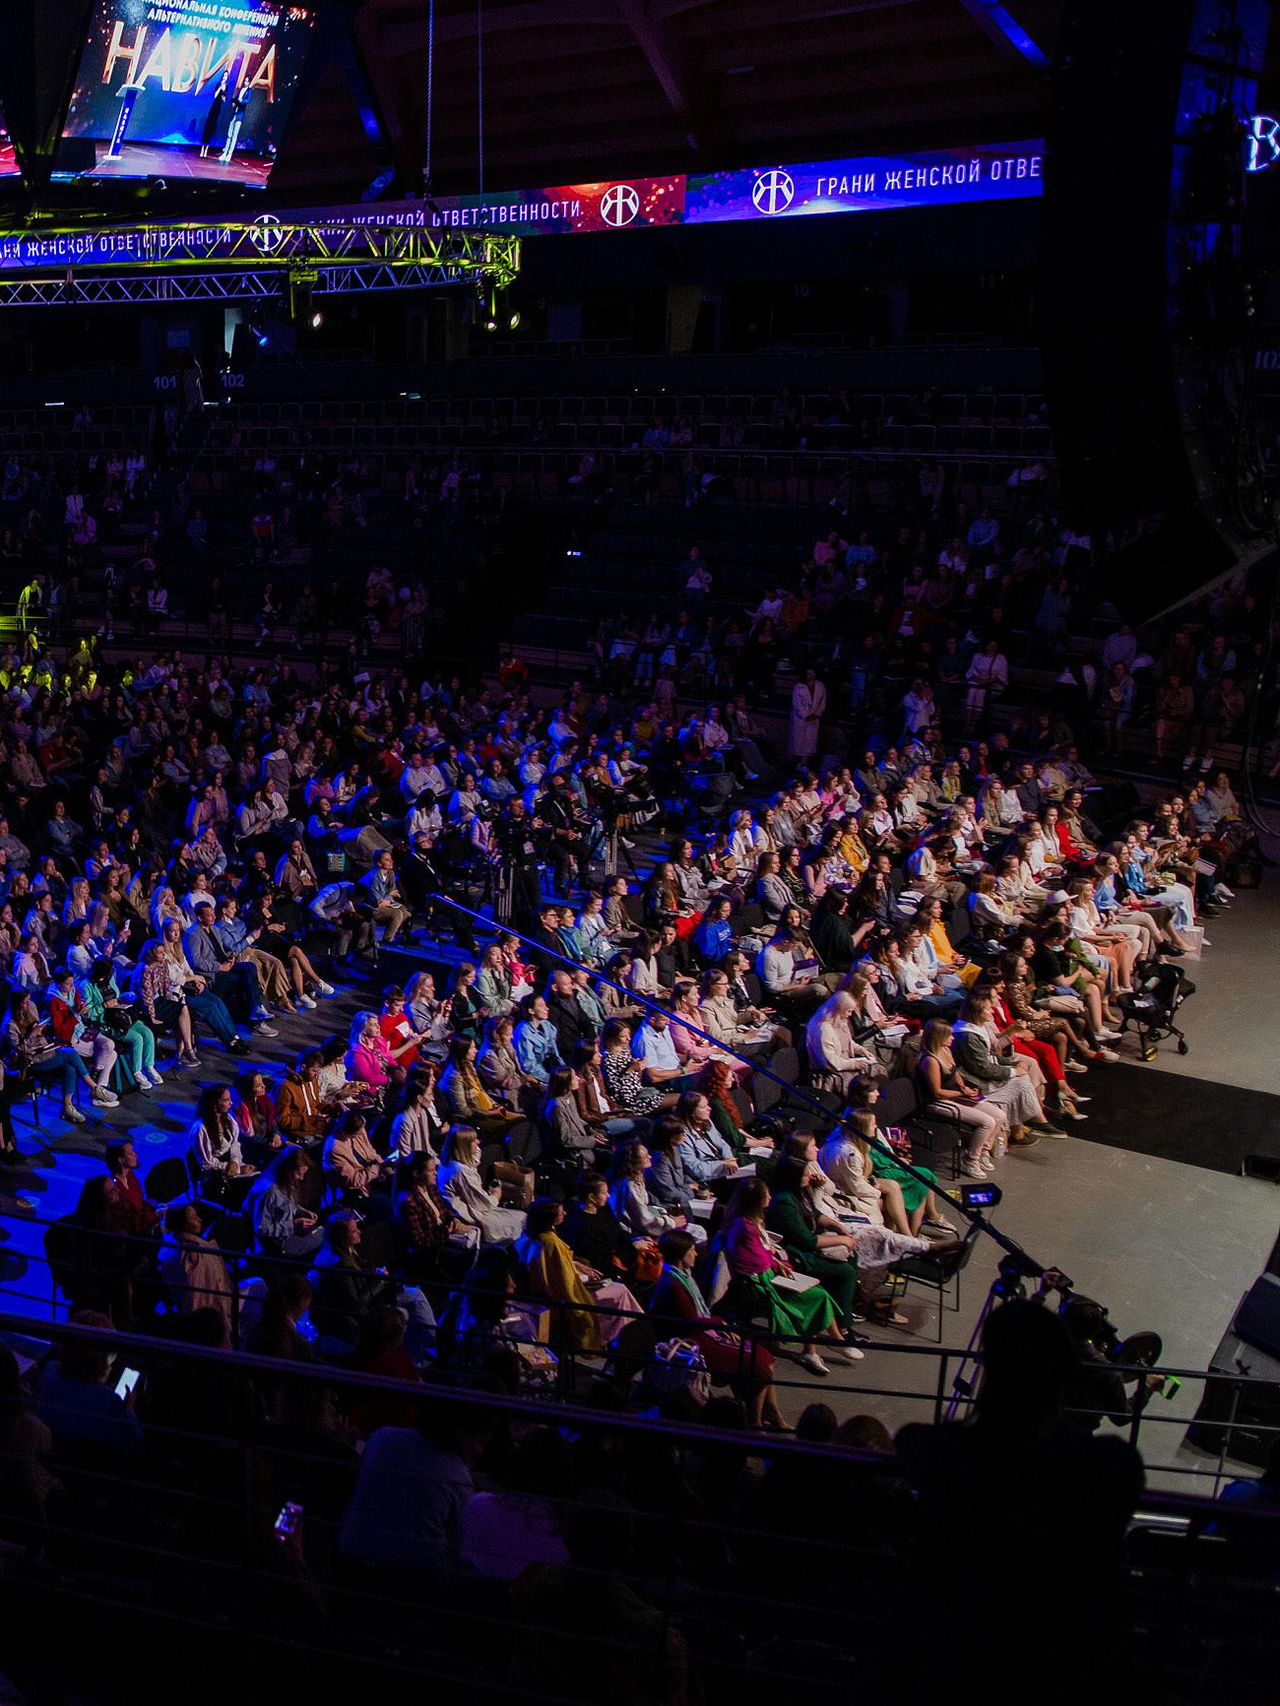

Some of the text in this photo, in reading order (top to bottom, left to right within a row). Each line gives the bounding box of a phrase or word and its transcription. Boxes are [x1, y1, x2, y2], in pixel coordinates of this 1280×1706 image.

[101, 21, 278, 103] НАВИТА
[816, 156, 1042, 196] ГРАНИ ЖЕНСКОЙ ОТВЕ
[27, 234, 94, 257] ЖЕНСКОЙ
[100, 228, 232, 252] ОТВЕТСТВЕННОСТИ
[153, 376, 177, 390] 101
[221, 374, 245, 388] 102
